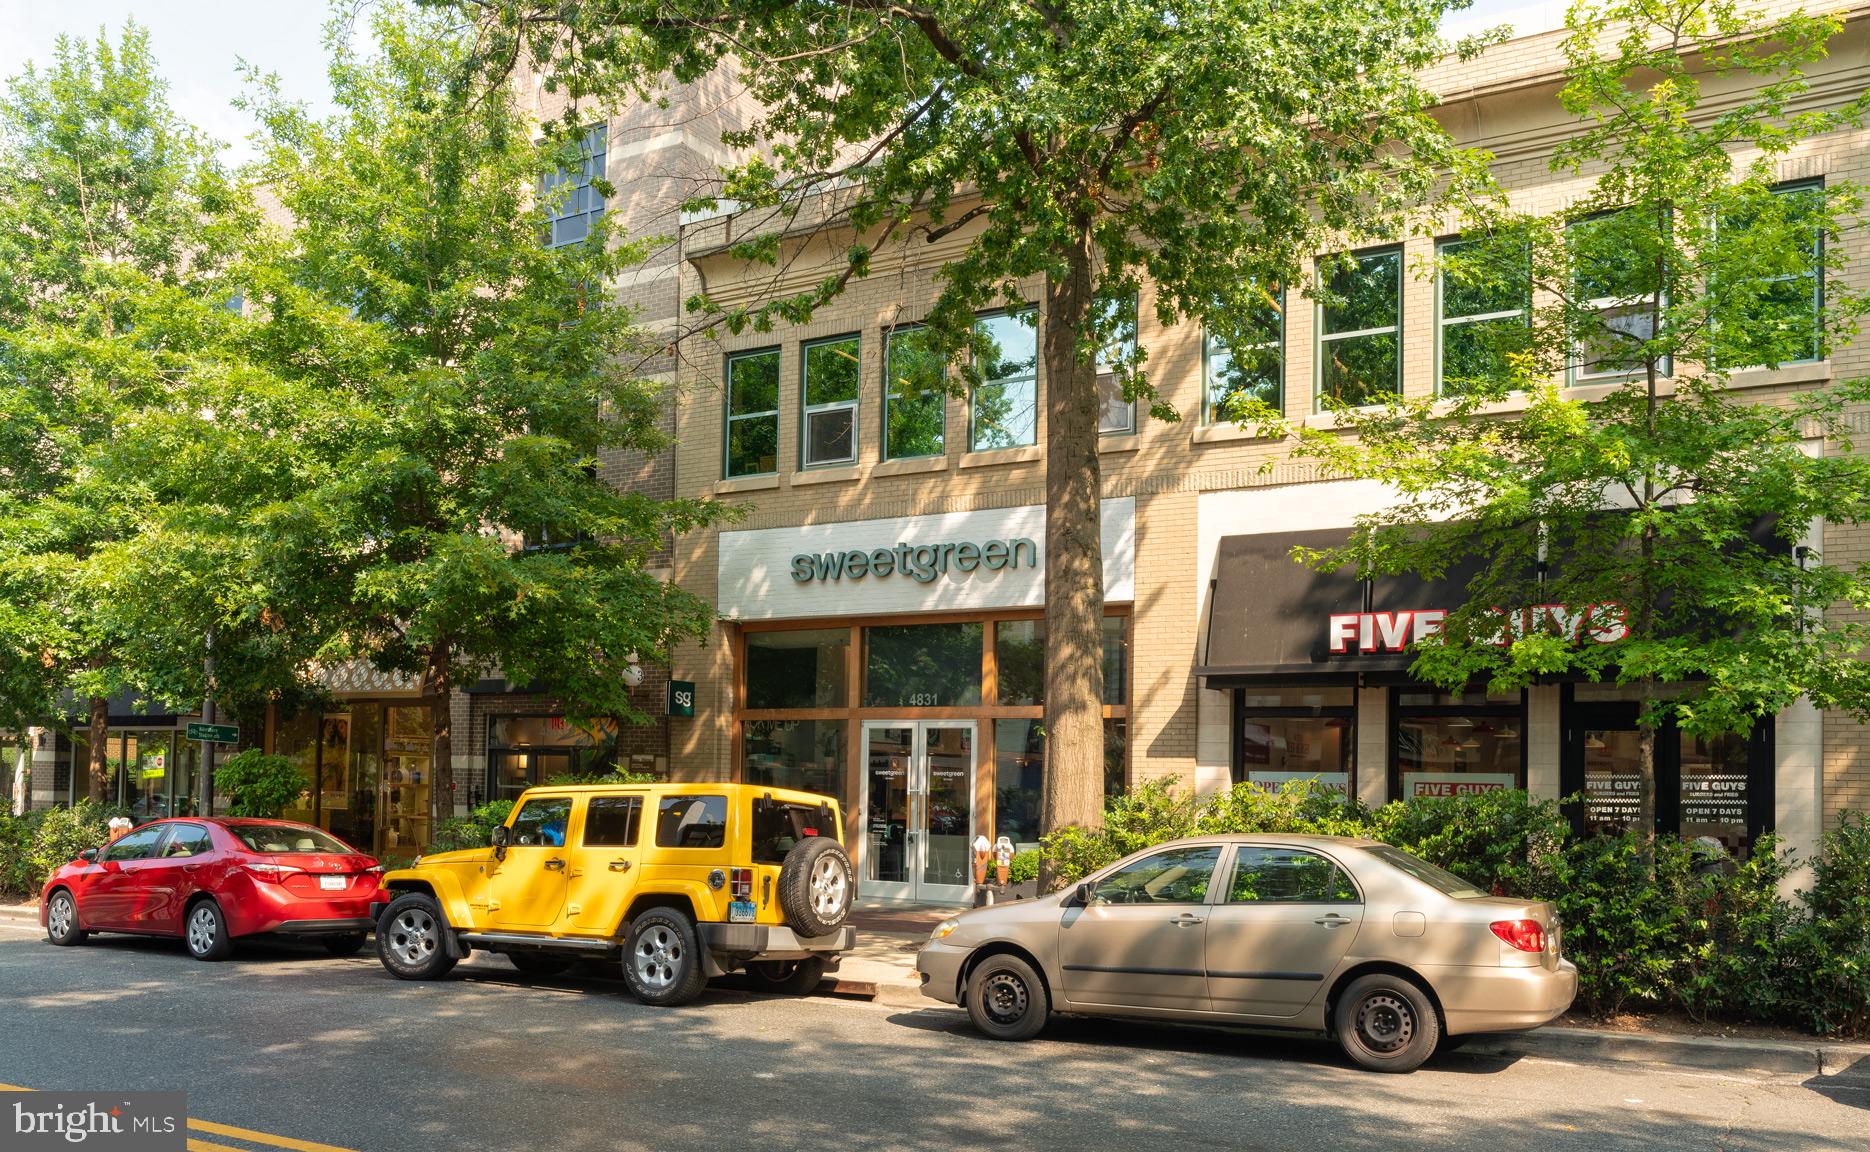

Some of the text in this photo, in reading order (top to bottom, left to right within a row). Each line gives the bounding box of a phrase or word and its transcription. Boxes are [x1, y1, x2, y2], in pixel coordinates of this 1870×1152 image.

[790, 538, 1037, 583] sweetgreen
[1329, 609, 1448, 652] FIVE
[675, 691, 691, 707] sg
[909, 693, 938, 706] 4831
[1252, 780, 1282, 794] OPE
[1415, 783, 1451, 795] FIVE
[1586, 781, 1640, 790] FIVE GUY
[1682, 781, 1746, 790] FIVE GUYS
[1686, 807, 1710, 815] OPEN
